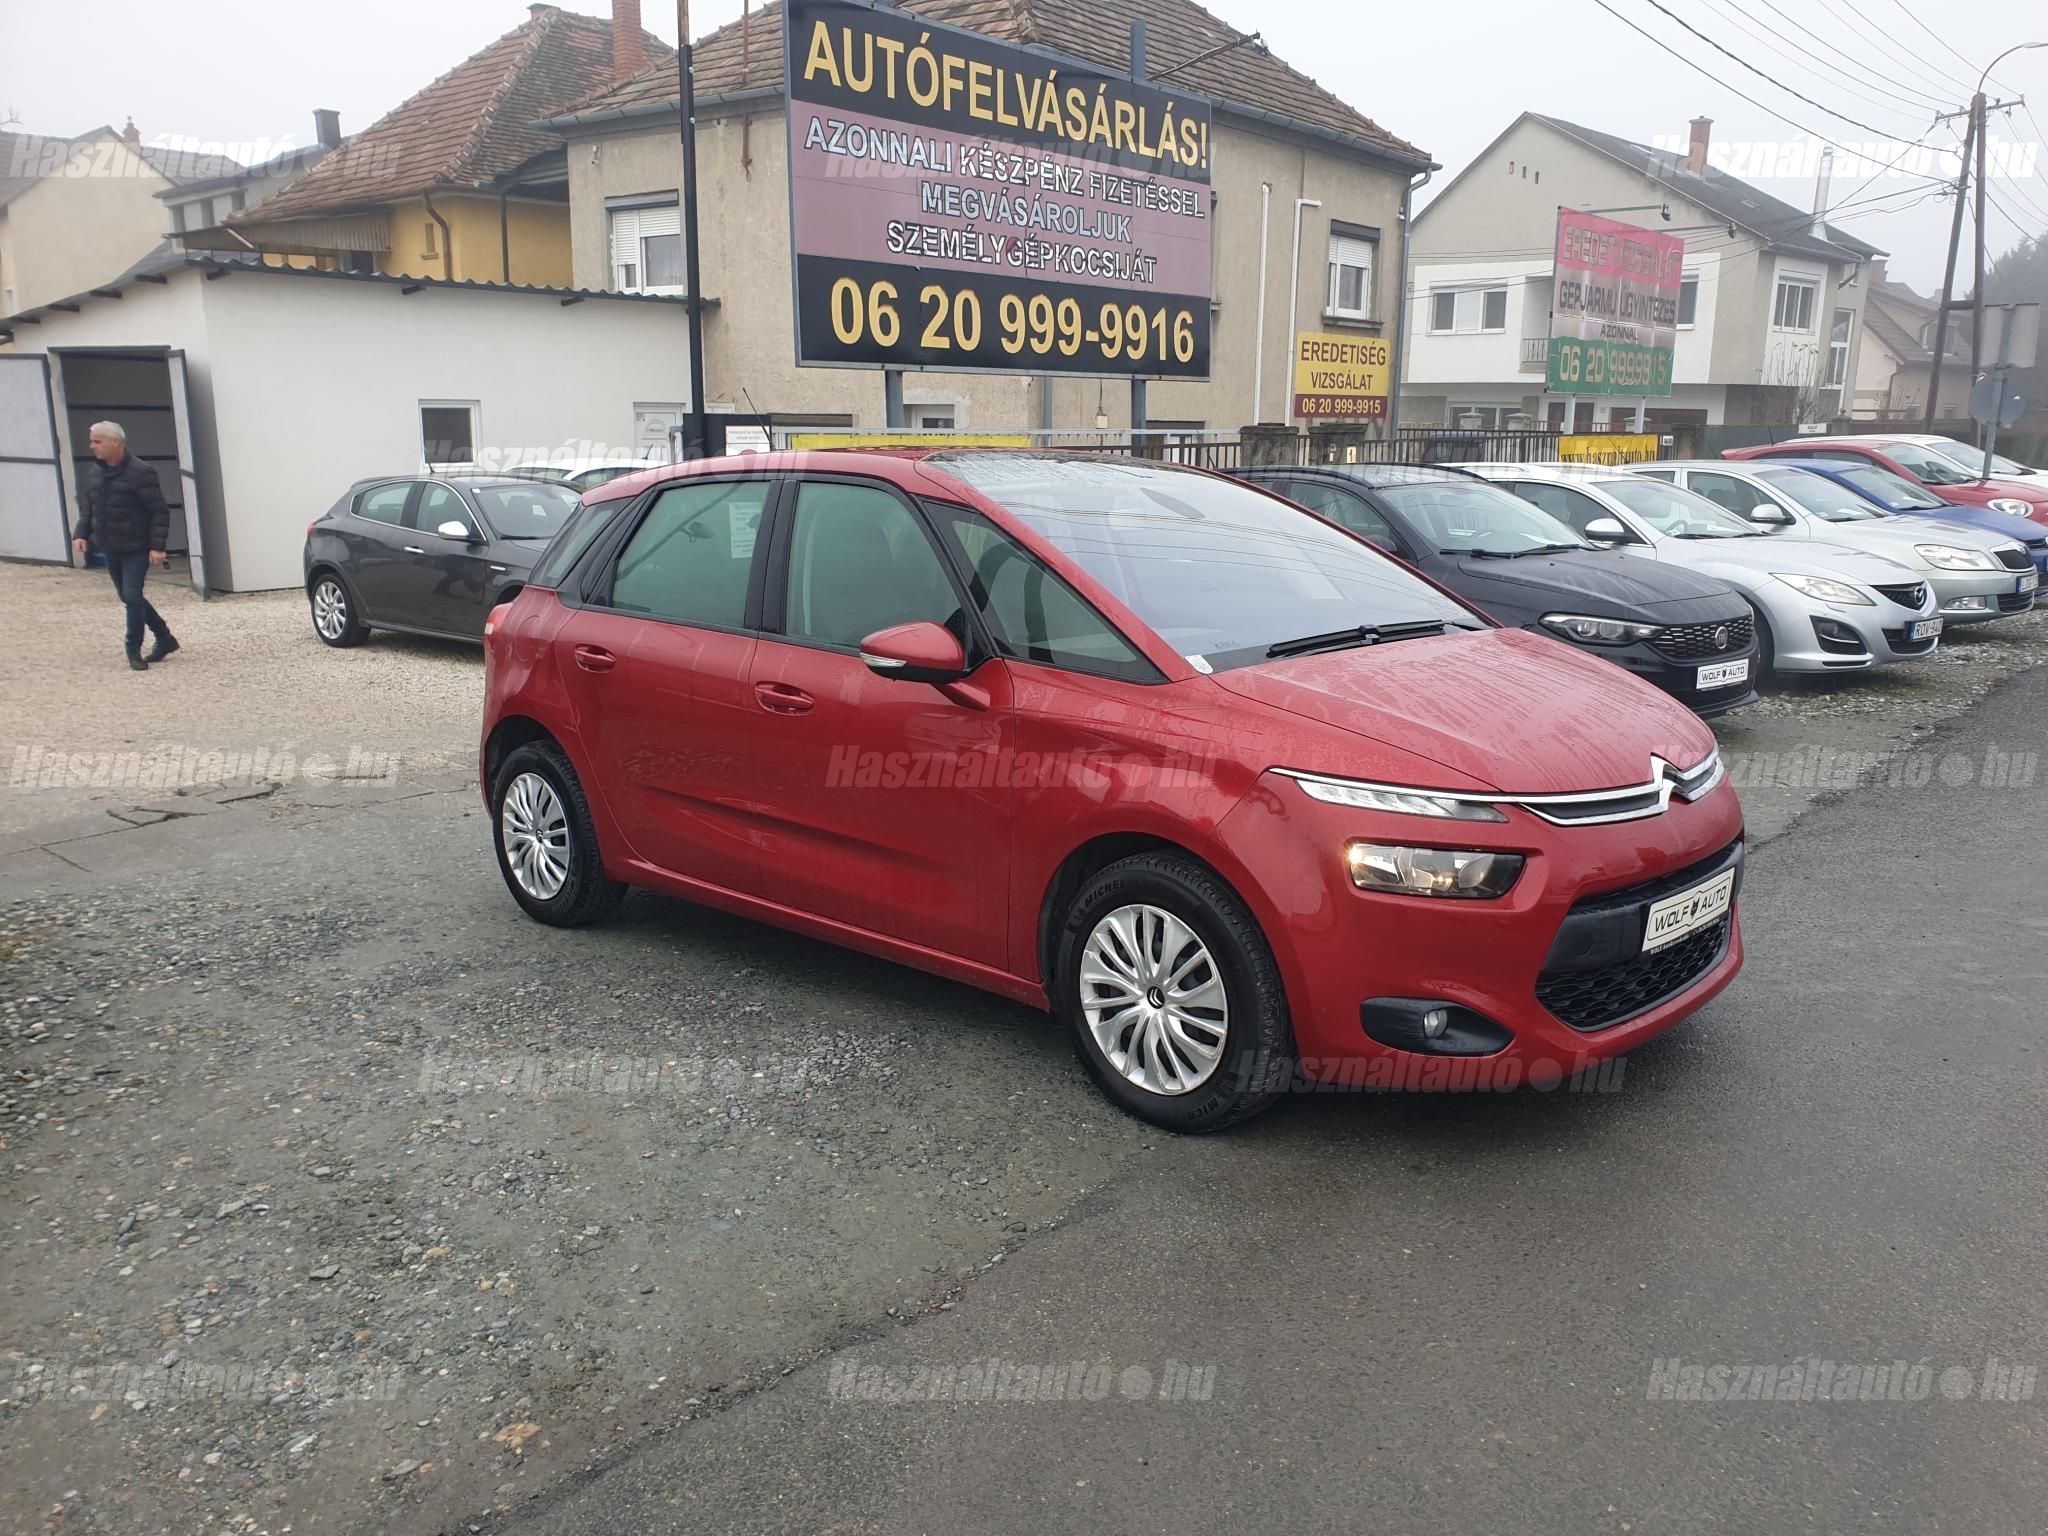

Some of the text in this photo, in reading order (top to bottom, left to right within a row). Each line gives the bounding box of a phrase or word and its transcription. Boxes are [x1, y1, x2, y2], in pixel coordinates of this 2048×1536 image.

[804, 20, 1207, 168] AUTÓFELVÁSÁRLÁS!
[804, 117, 1206, 218] AZONNALI KÉSZPÉNZ FIZETÉSSEL
[921, 182, 1133, 243] MEGVÁSÁROLJUK
[886, 221, 1158, 284] SZEMÉLYGÉPKOCSIJÁT
[831, 277, 1195, 363] 06 20 999-9916
[1301, 341, 1386, 366] EREDETISÉG
[1559, 345, 1581, 382] 06
[1585, 347, 1605, 383] 20
[1311, 370, 1373, 390] VIZSGÁLAT
[1302, 398, 1381, 414] 06 20 999-9915
[1701, 666, 1745, 681] WOLF AUTO
[1654, 904, 1690, 932] WOLF
[1699, 885, 1728, 912] AUTO
